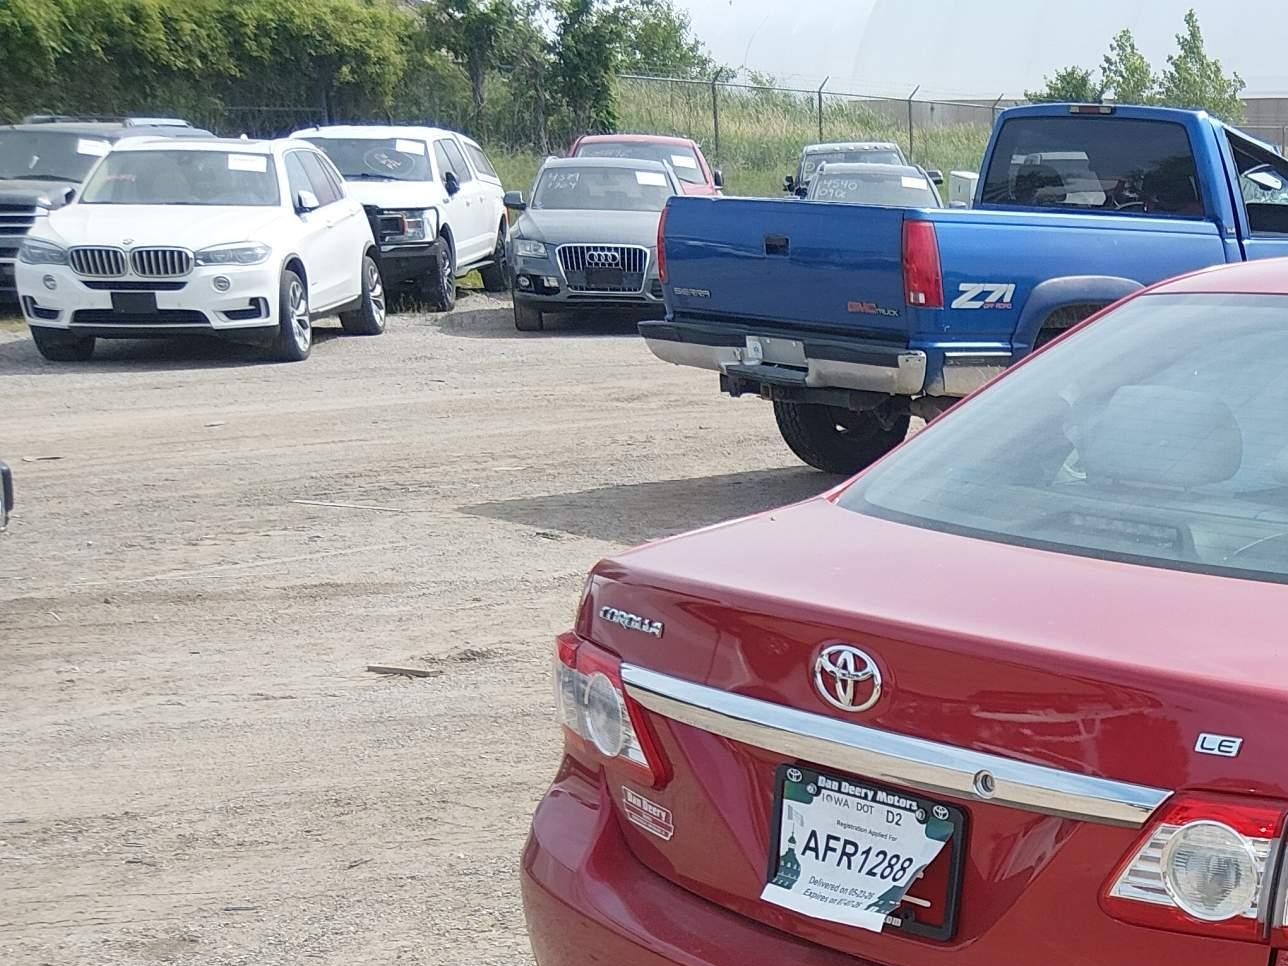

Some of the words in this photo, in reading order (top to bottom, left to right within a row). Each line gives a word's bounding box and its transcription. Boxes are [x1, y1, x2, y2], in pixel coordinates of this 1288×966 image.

[673, 287, 712, 299] SIERRA
[951, 283, 1016, 309] Z71
[847, 301, 876, 314] GMC
[875, 308, 899, 317] TRUCK
[600, 606, 663, 638] COROLLA
[1198, 735, 1239, 755] LE
[818, 775, 839, 791] Dan
[840, 781, 875, 801] Deery
[876, 790, 918, 810] Motors
[821, 792, 850, 809] IOWA
[856, 802, 876, 815] DOT
[885, 809, 903, 827] D2
[836, 818, 868, 834] Registration
[868, 828, 889, 840] Applied
[800, 829, 915, 883] AFR1288
[803, 888, 830, 903] Expires
[808, 875, 841, 893] Delivered
[839, 887, 849, 895] on
